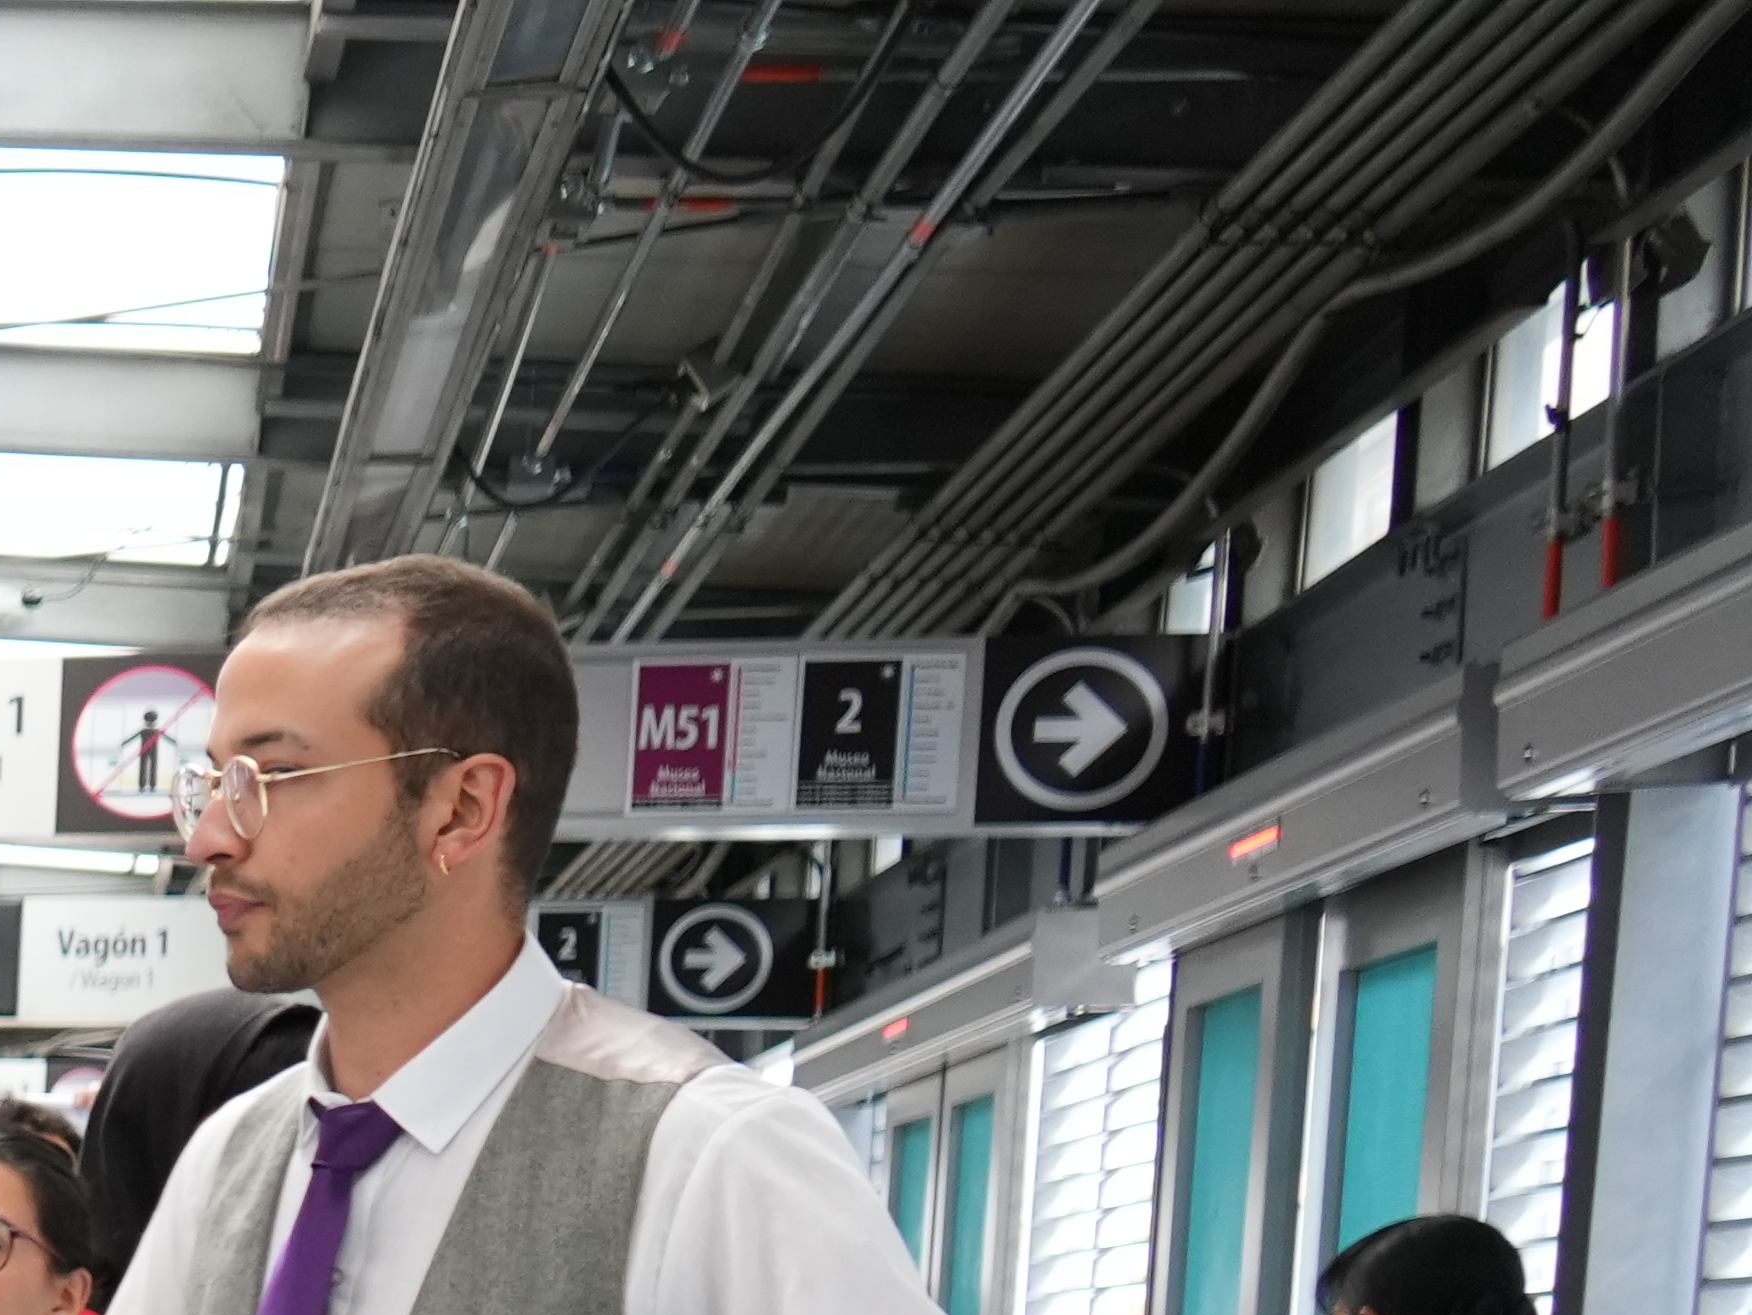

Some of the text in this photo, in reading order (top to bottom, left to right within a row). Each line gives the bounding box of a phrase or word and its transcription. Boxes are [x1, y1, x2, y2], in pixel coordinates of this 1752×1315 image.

[8, 695, 25, 735] 1
[639, 703, 721, 750] M51
[834, 686, 864, 735] 2
[57, 926, 170, 963] Vagón 1
[557, 925, 578, 961] 2
[146, 968, 154, 988] 1
